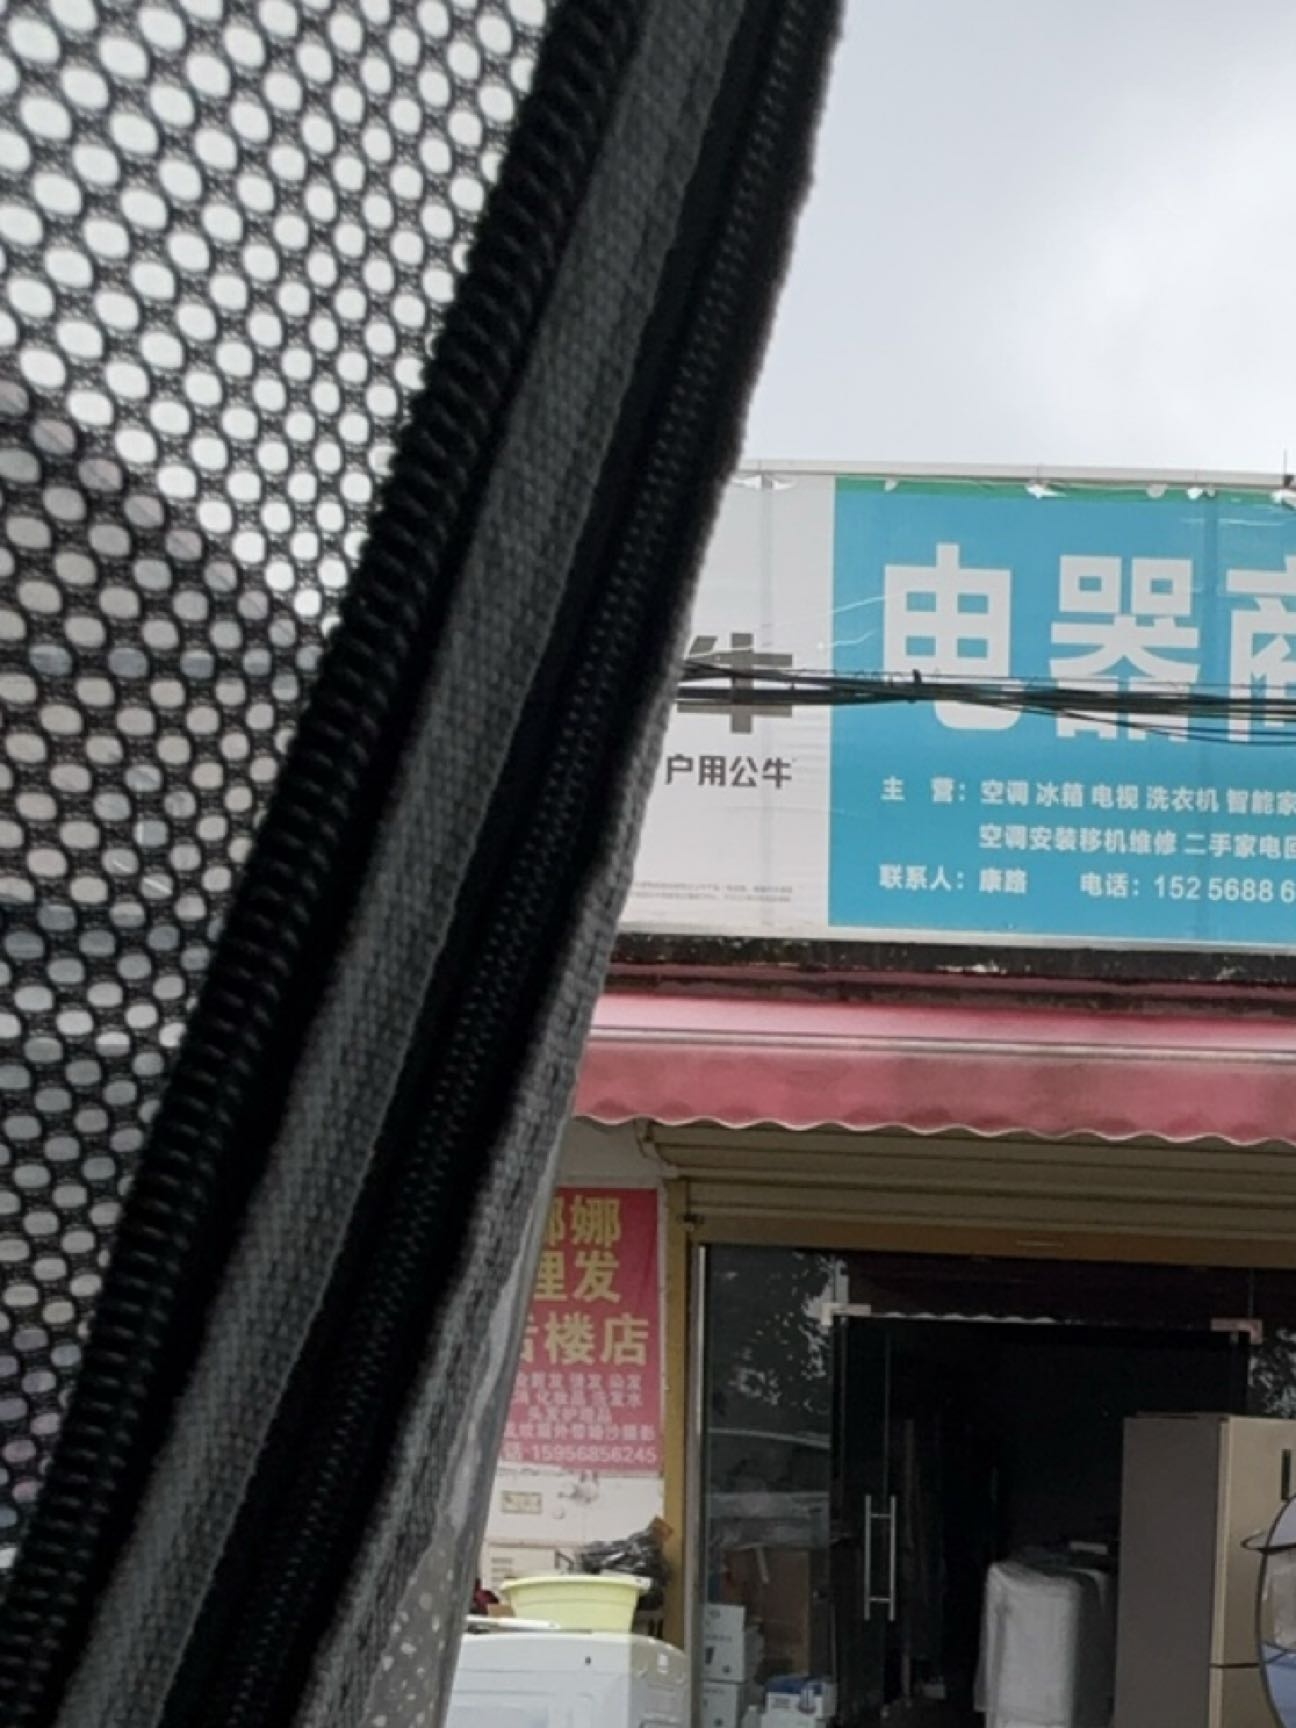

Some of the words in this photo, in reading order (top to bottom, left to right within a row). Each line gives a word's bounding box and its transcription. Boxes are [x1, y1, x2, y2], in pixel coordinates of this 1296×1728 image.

[665, 754, 793, 790] 户用公牛
[1036, 781, 1085, 808] 冰箱
[1091, 784, 1140, 810] 电视
[1146, 785, 1220, 813] 洗衣机
[979, 823, 1178, 856] 空调安装移机维修
